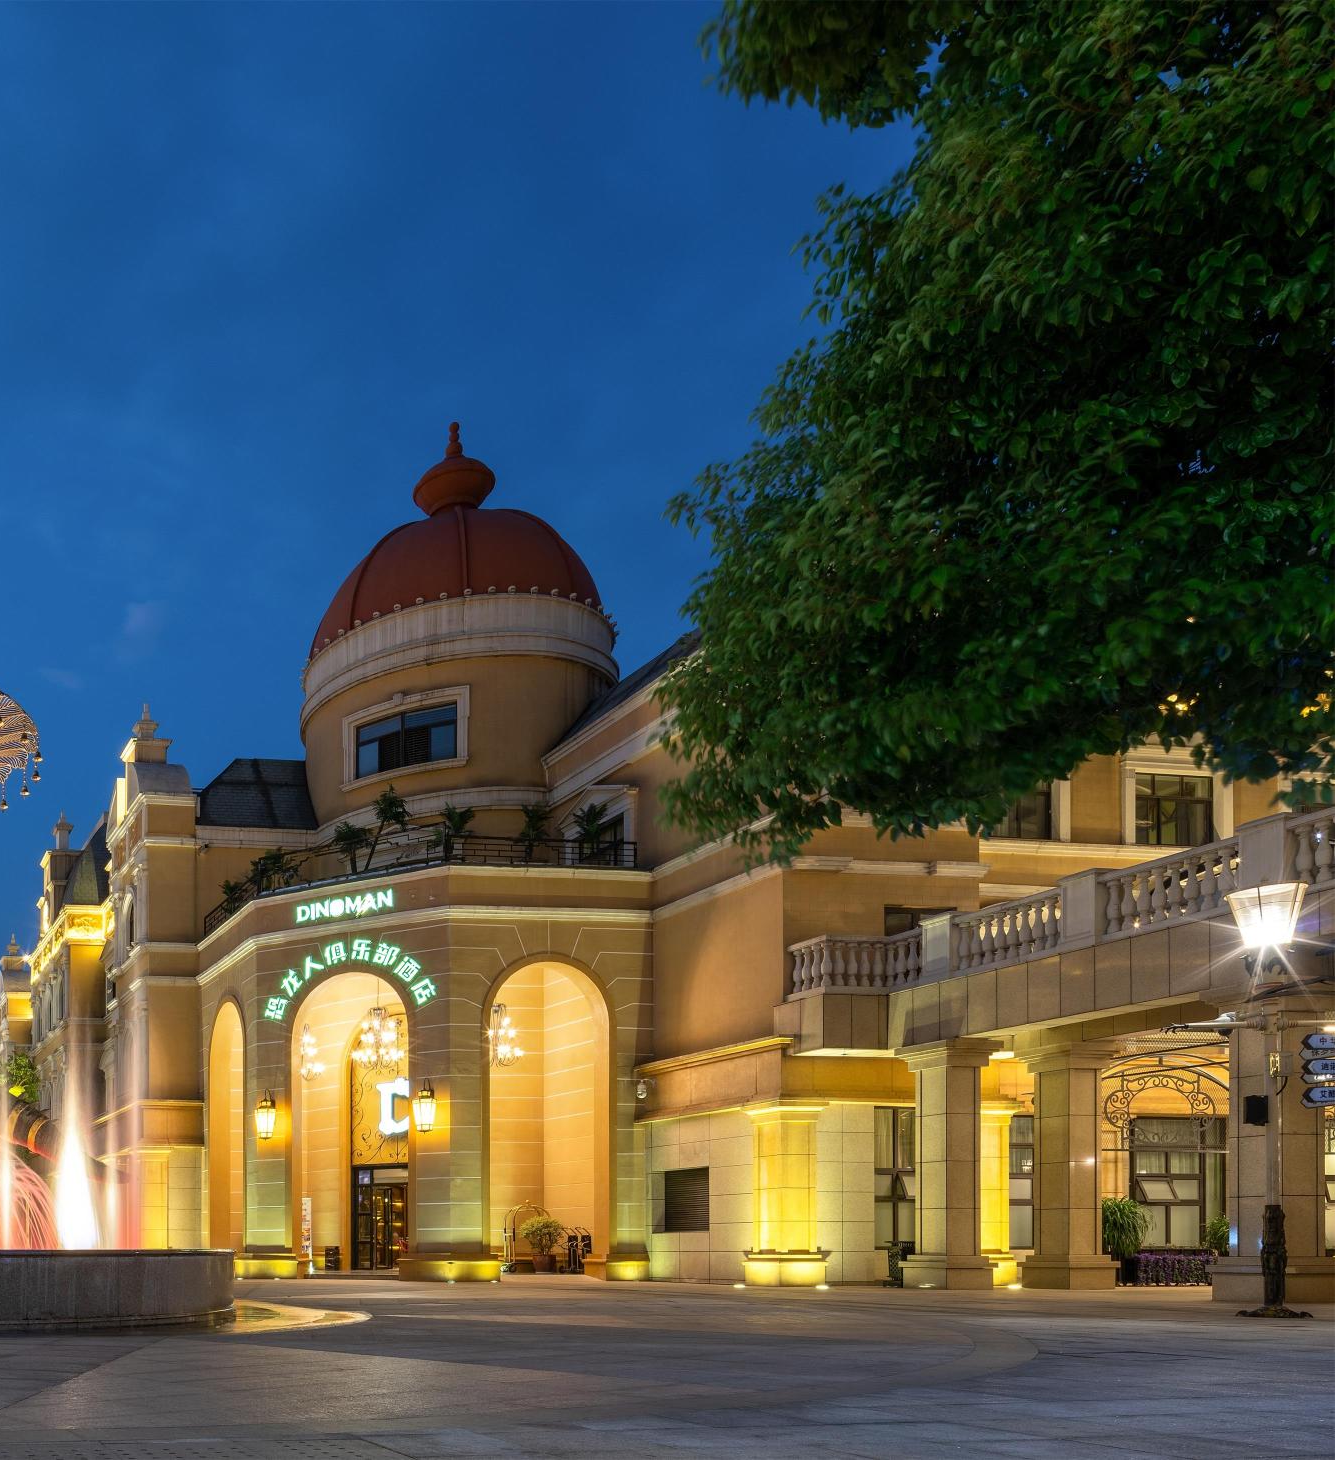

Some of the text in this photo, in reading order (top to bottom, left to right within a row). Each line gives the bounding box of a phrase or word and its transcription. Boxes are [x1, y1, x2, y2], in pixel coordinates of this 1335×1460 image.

[296, 888, 393, 924] DINOMAN
[263, 938, 437, 1020] 恐龙人俱乐部酒店
